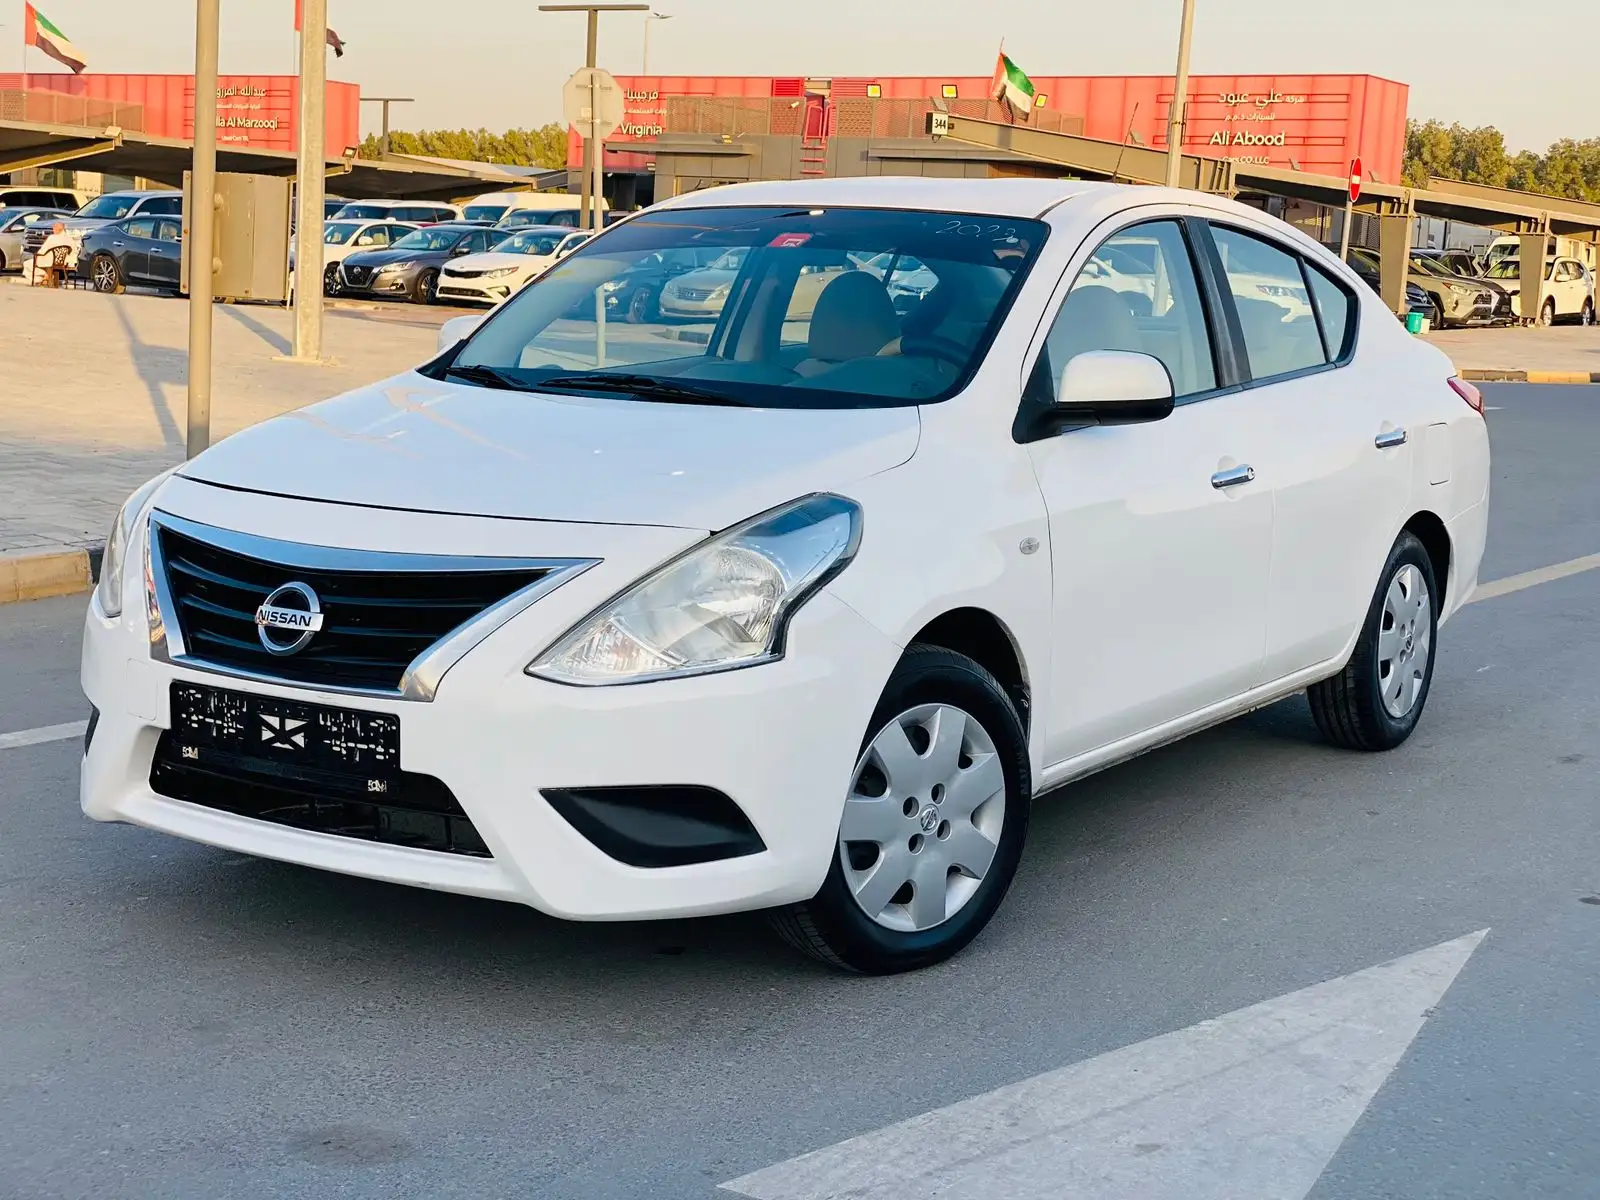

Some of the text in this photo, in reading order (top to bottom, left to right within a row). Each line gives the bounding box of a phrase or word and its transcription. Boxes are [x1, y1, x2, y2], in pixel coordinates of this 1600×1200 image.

[216, 85, 237, 98] المرزو
[626, 88, 659, 102] فرجينيا
[1218, 92, 1249, 107] عبود
[1255, 88, 1283, 109] علي
[226, 116, 236, 128] Al
[237, 115, 279, 131] Marzooqi
[620, 121, 663, 138] Virginia
[934, 118, 947, 130] 344
[1209, 130, 1286, 146] Ali Abood
[257, 608, 312, 627] NISSAN
